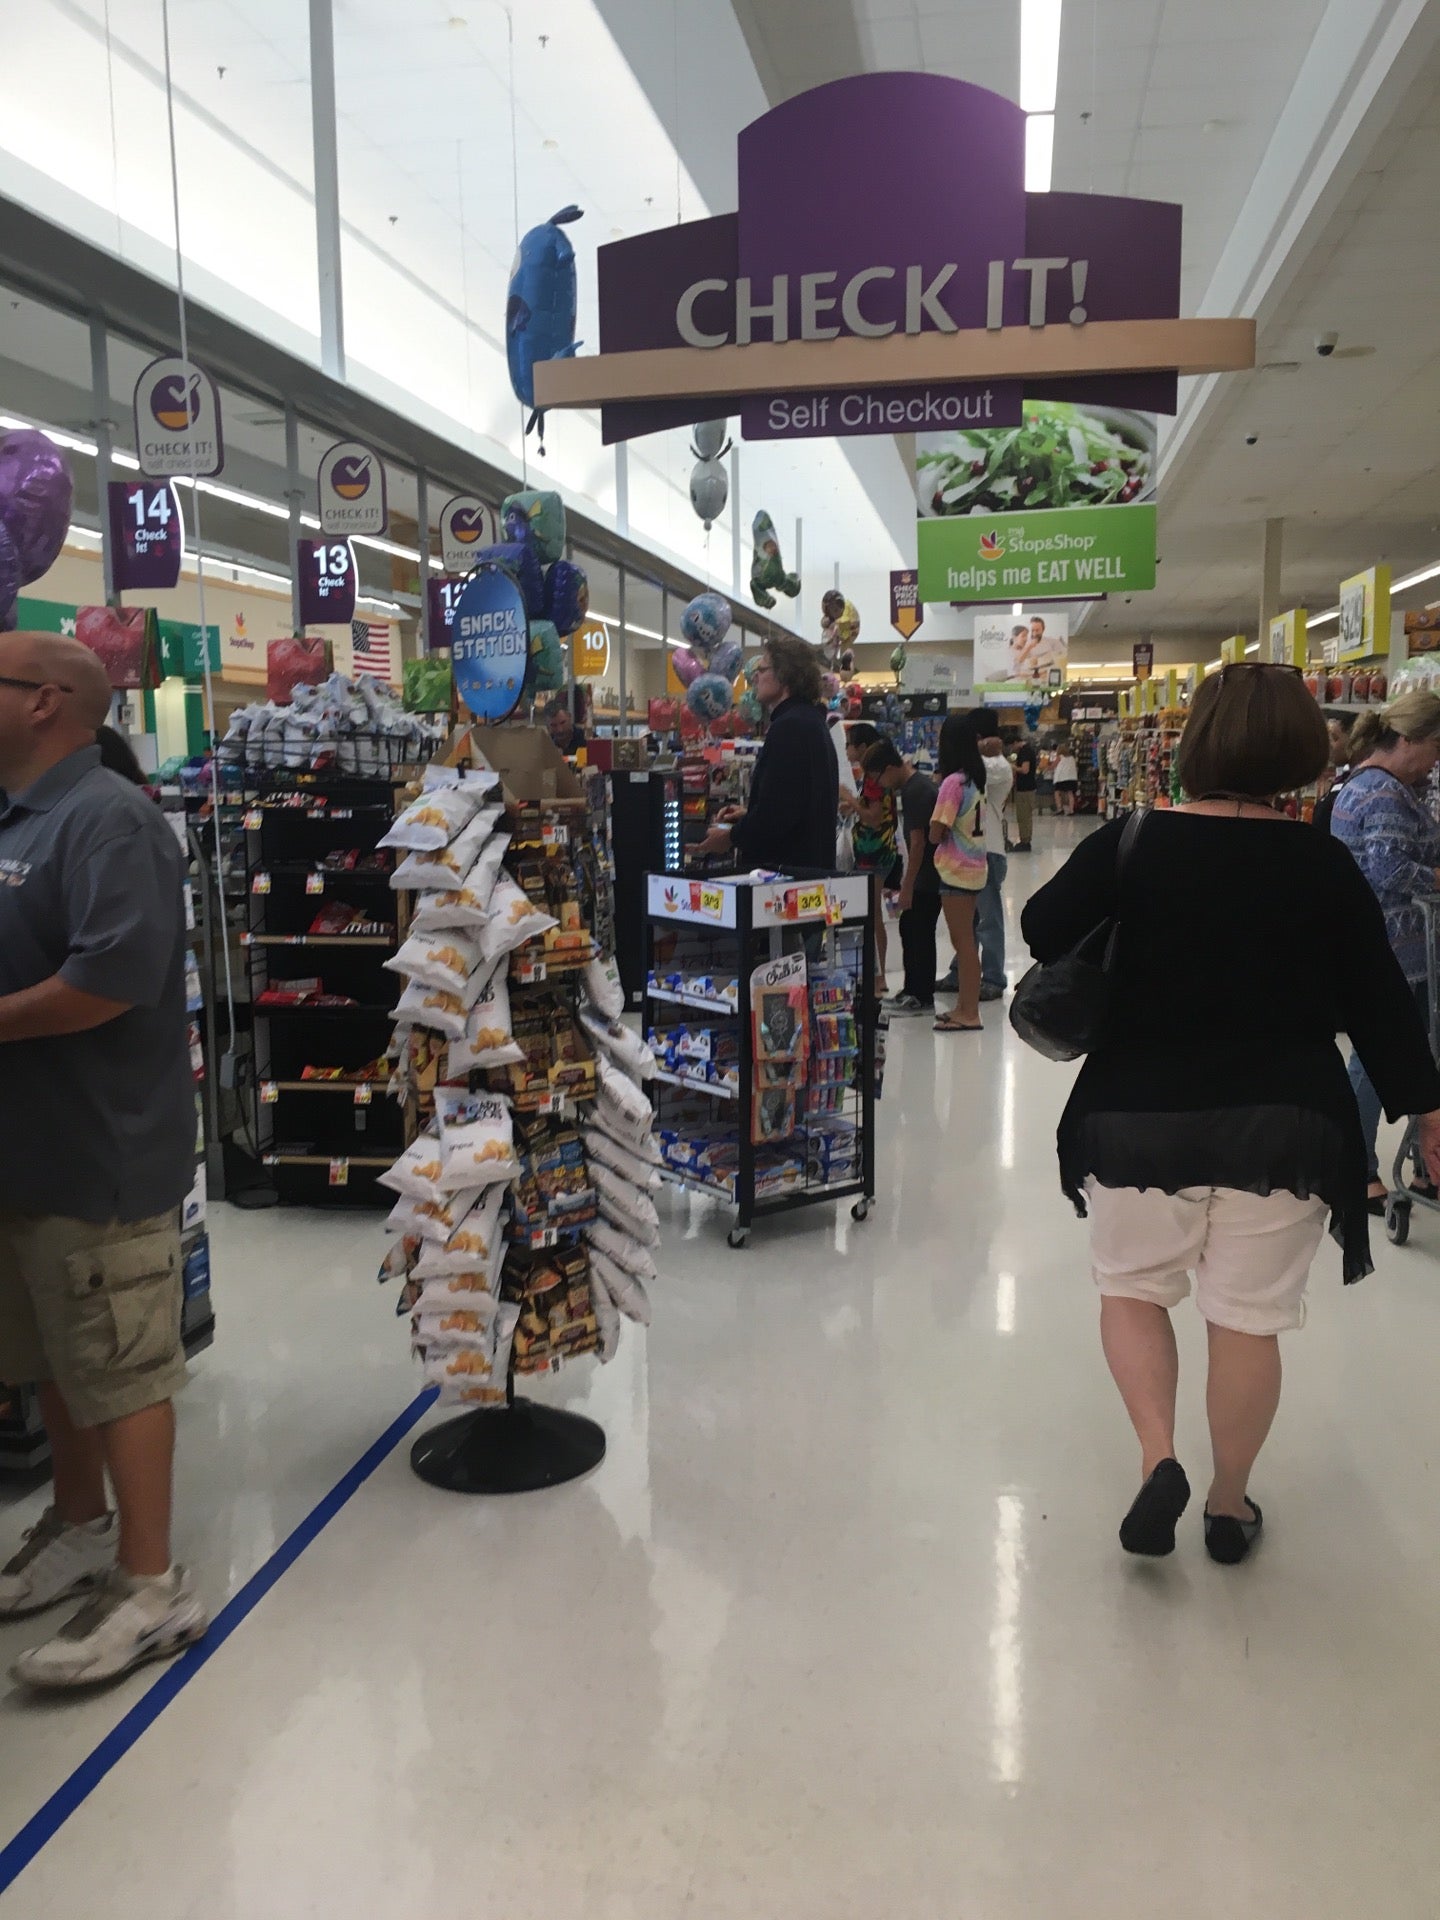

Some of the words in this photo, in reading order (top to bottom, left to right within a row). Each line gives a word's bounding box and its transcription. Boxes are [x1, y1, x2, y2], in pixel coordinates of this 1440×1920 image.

[676, 262, 959, 348] CHECK
[987, 256, 1090, 331] IT!
[768, 395, 830, 431] Self
[840, 388, 994, 427] Checkout
[145, 442, 191, 457] CHECK
[128, 488, 171, 526] 14
[325, 508, 361, 519] CHECK
[135, 528, 168, 541] Check
[136, 542, 148, 554] It!
[313, 544, 349, 575] 13
[318, 576, 345, 588] Check
[947, 566, 997, 591] helps
[1003, 567, 1031, 586] me
[1037, 560, 1070, 584] EAT
[1075, 556, 1126, 580] WELL
[893, 584, 918, 593] CHECK
[895, 591, 918, 600] PRICE
[460, 609, 517, 637] SNACK
[453, 630, 527, 661] STATION
[582, 631, 604, 651] 10
